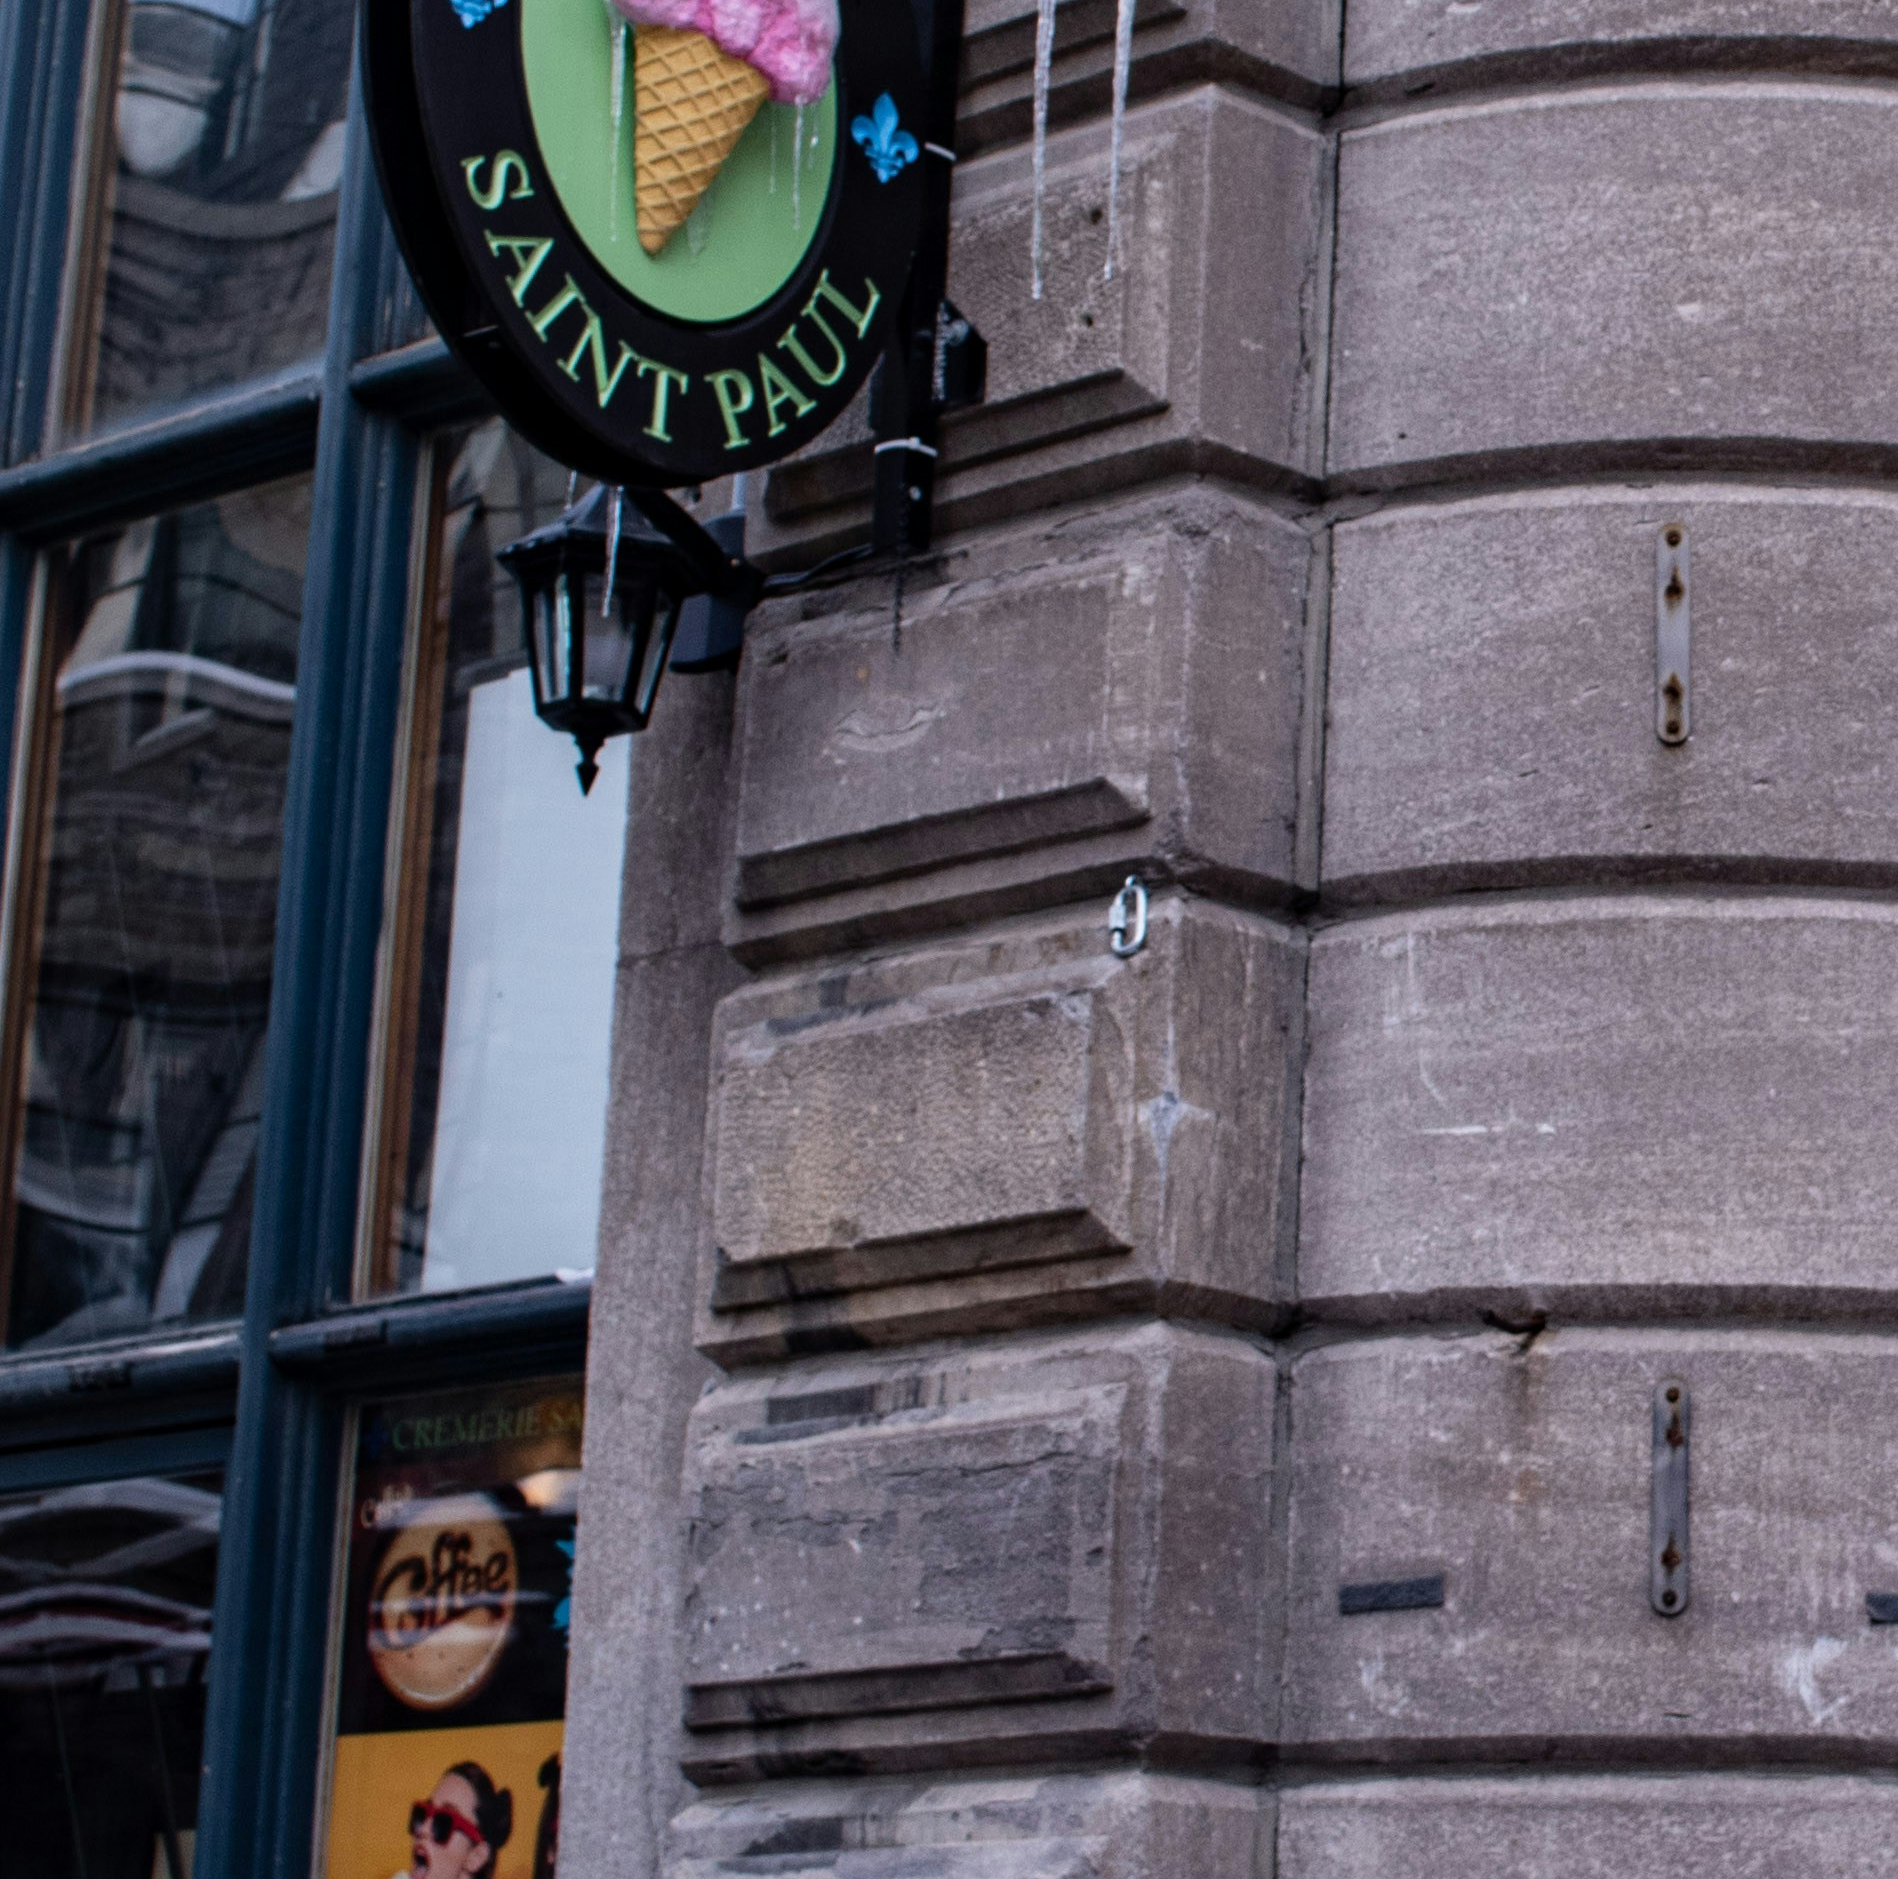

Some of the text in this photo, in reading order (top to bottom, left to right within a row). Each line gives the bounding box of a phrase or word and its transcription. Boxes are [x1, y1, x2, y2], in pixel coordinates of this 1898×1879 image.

[461, 148, 690, 444] SAINT
[703, 267, 881, 451] PAUL
[391, 1406, 537, 1451] CREMERIE
